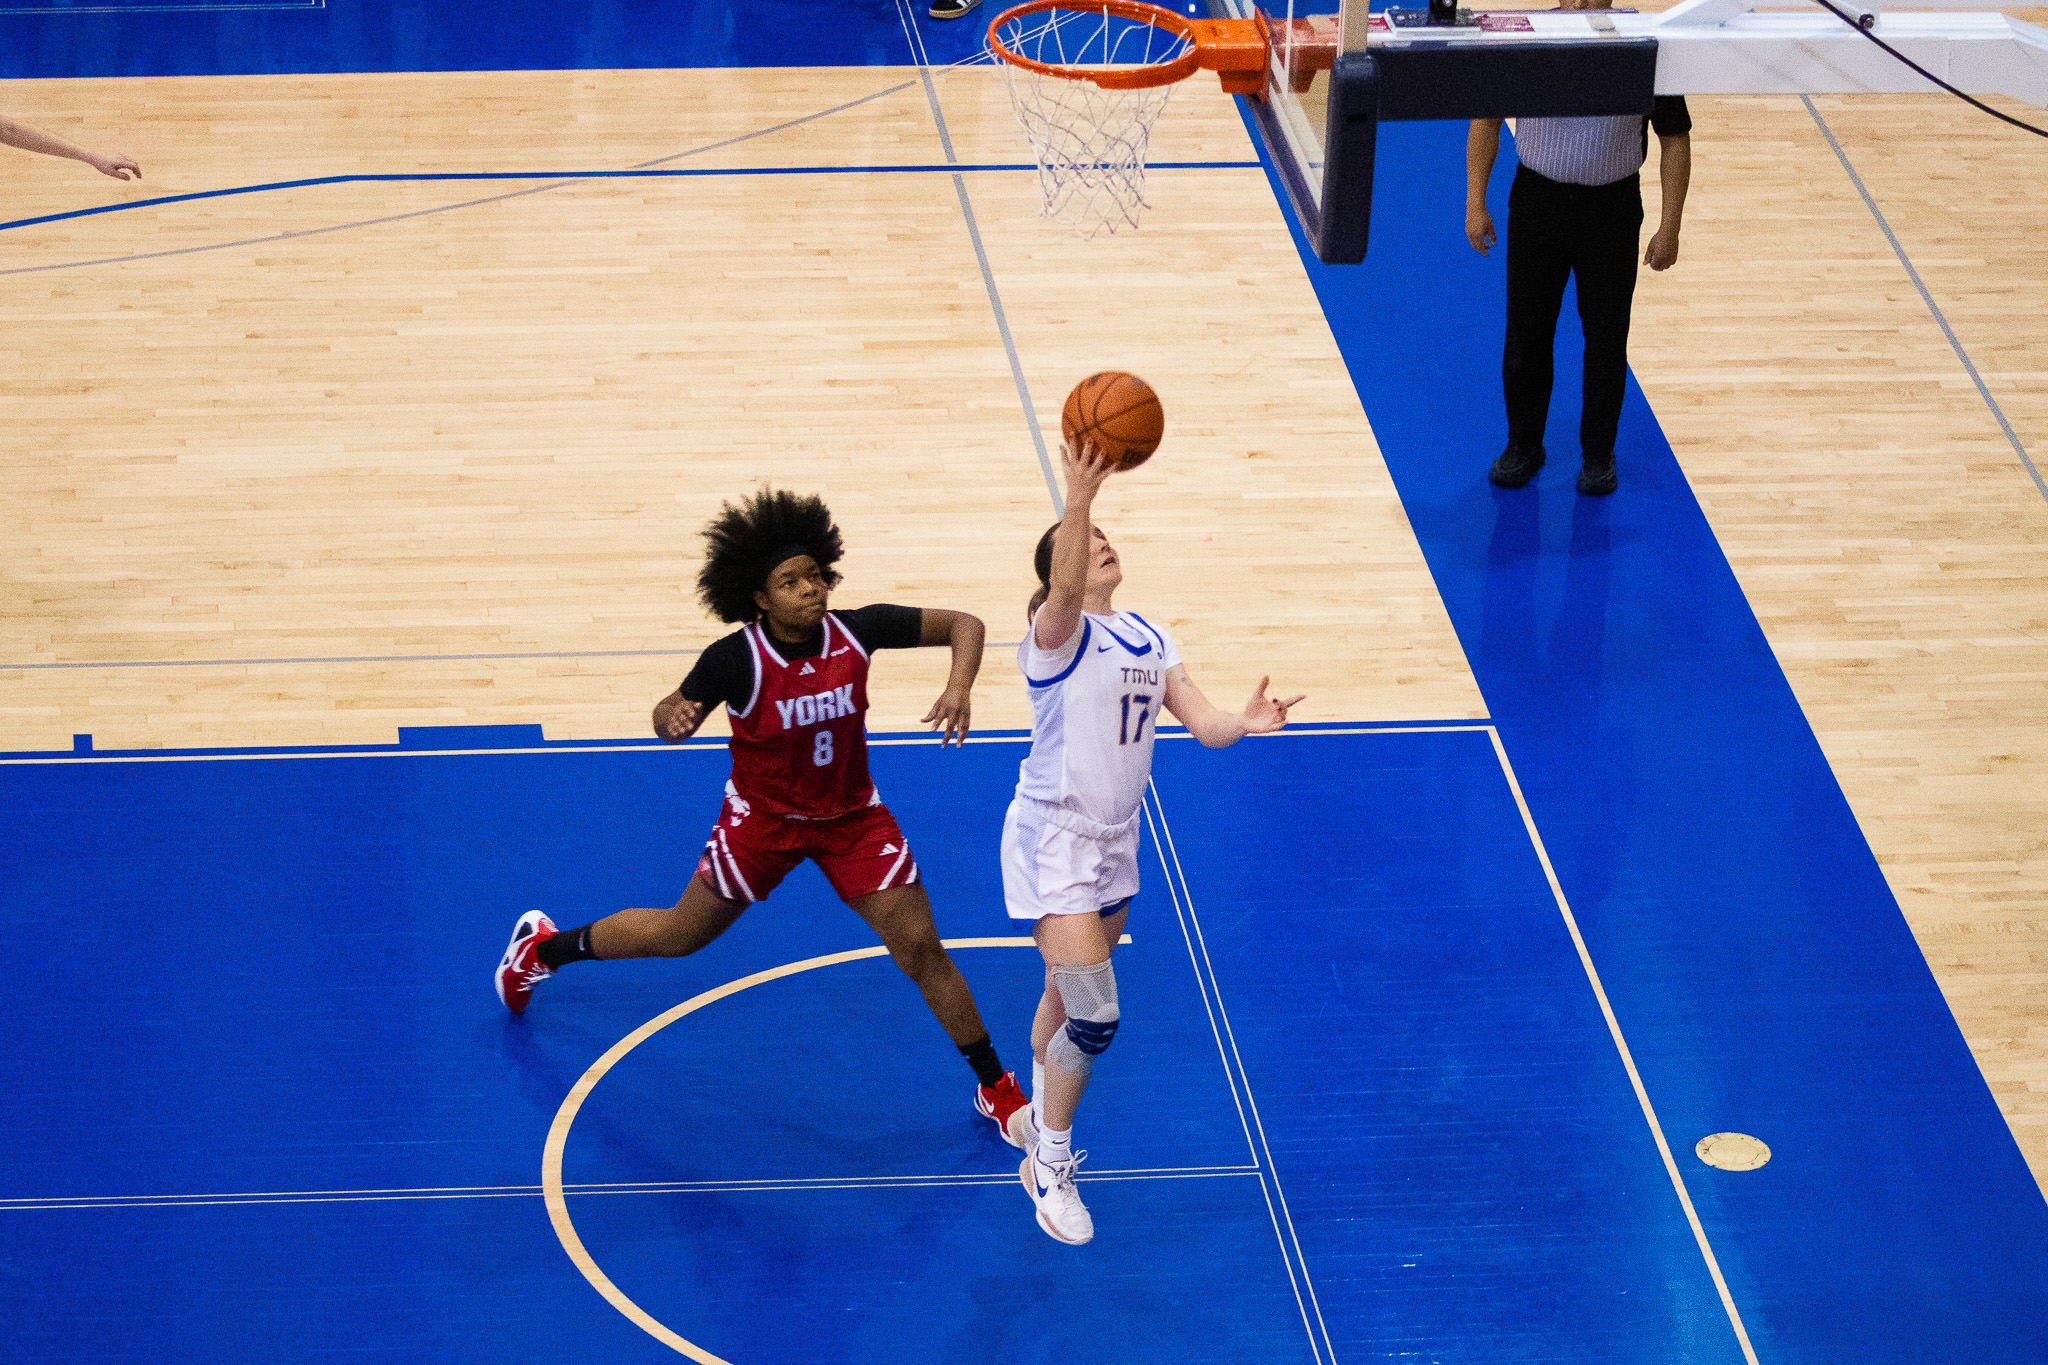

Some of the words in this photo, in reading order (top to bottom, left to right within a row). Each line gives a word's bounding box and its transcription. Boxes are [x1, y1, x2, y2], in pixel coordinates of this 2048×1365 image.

[1120, 667, 1158, 686] TMU
[775, 683, 857, 730] YORK
[1119, 693, 1152, 746] 17
[813, 730, 834, 767] 8
